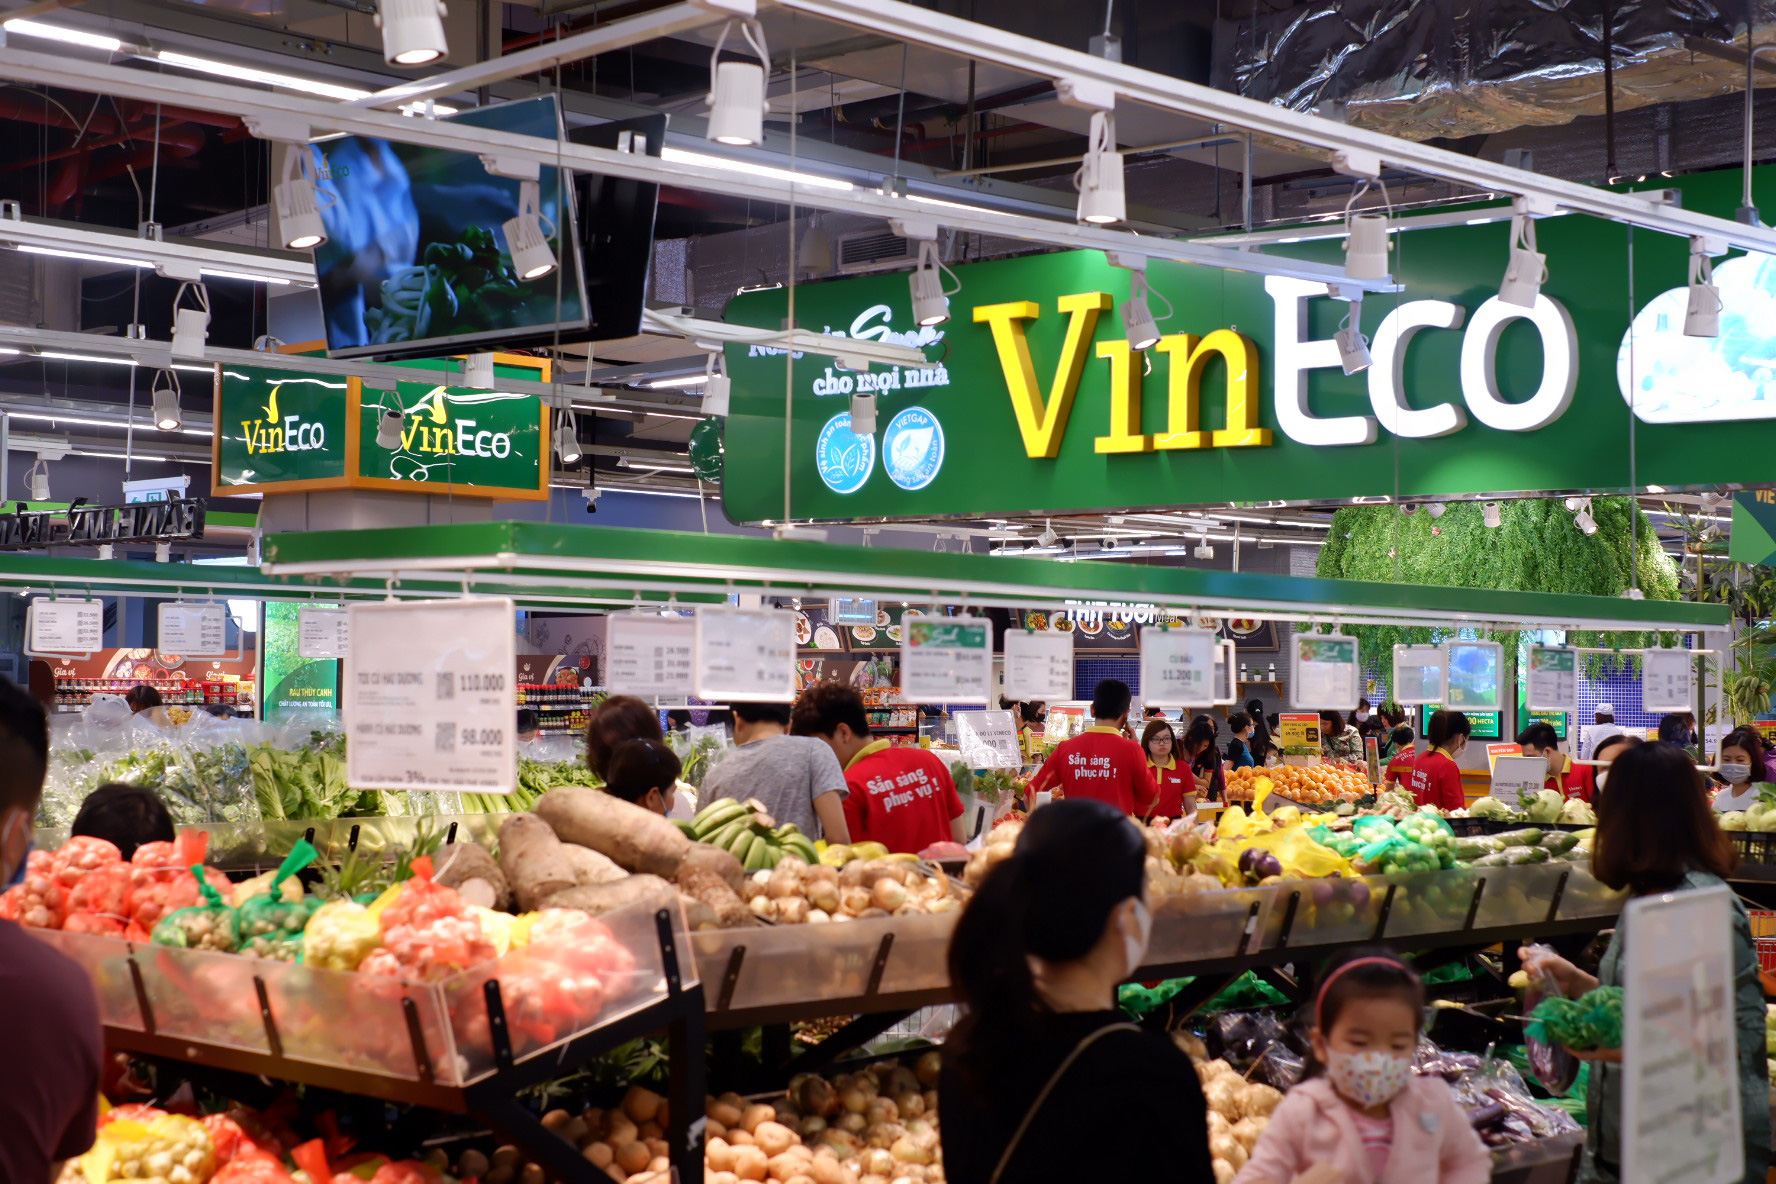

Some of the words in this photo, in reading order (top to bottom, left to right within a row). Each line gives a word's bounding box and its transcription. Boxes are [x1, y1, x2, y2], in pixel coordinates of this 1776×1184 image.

[973, 275, 1579, 458] VinEco
[813, 368, 853, 395] cho
[895, 413, 928, 429] VIETGAP
[241, 415, 325, 455] VinEco
[401, 414, 511, 459] VinEco
[1068, 752, 1087, 766] Sẵn
[1089, 755, 1110, 769] sàng
[1074, 767, 1098, 780] phục
[1098, 770, 1110, 781] vụ
[1112, 768, 1117, 779] !
[866, 775, 896, 795] Sẵn
[895, 768, 928, 787] sàng
[883, 788, 914, 813] phục
[915, 784, 933, 799] vụ
[932, 777, 941, 791] !
